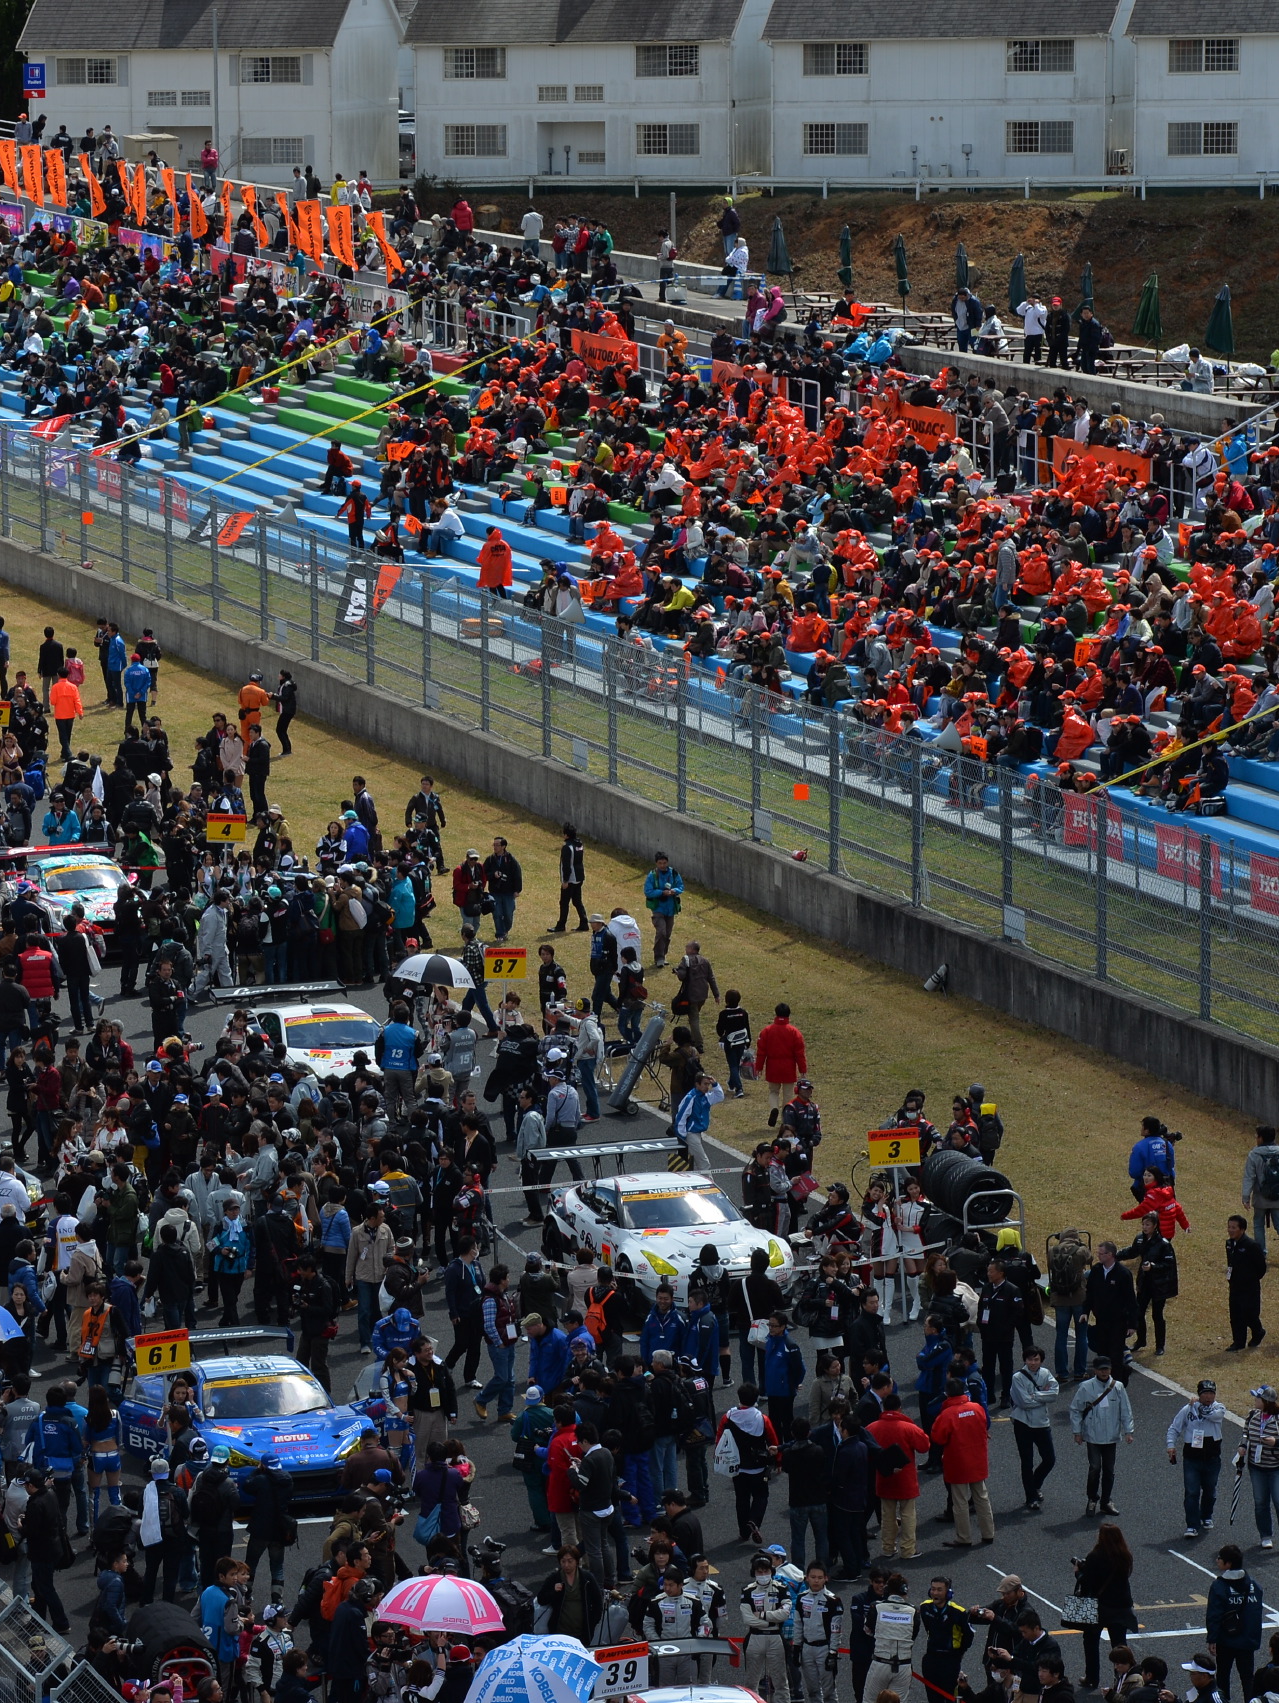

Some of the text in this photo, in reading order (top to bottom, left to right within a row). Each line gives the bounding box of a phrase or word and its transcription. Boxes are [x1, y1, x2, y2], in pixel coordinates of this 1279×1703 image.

[587, 349, 622, 363] AUTOBA
[221, 824, 231, 836] 4
[493, 958, 519, 973] 87
[391, 1049, 403, 1058] 13
[459, 1054, 470, 1064] 15
[549, 1142, 664, 1159] NISSAN
[888, 1141, 901, 1158] 3
[648, 1186, 694, 1194] NISSAN
[145, 1332, 186, 1342] AUTOBACS
[188, 1329, 264, 1339] erformance
[148, 1343, 177, 1366] 61
[129, 1425, 150, 1436] SUBARU
[274, 1434, 310, 1443] MOTUL
[274, 1445, 319, 1454] DENSO
[605, 1646, 646, 1658] AUTOBACS
[606, 1660, 638, 1686] 39
